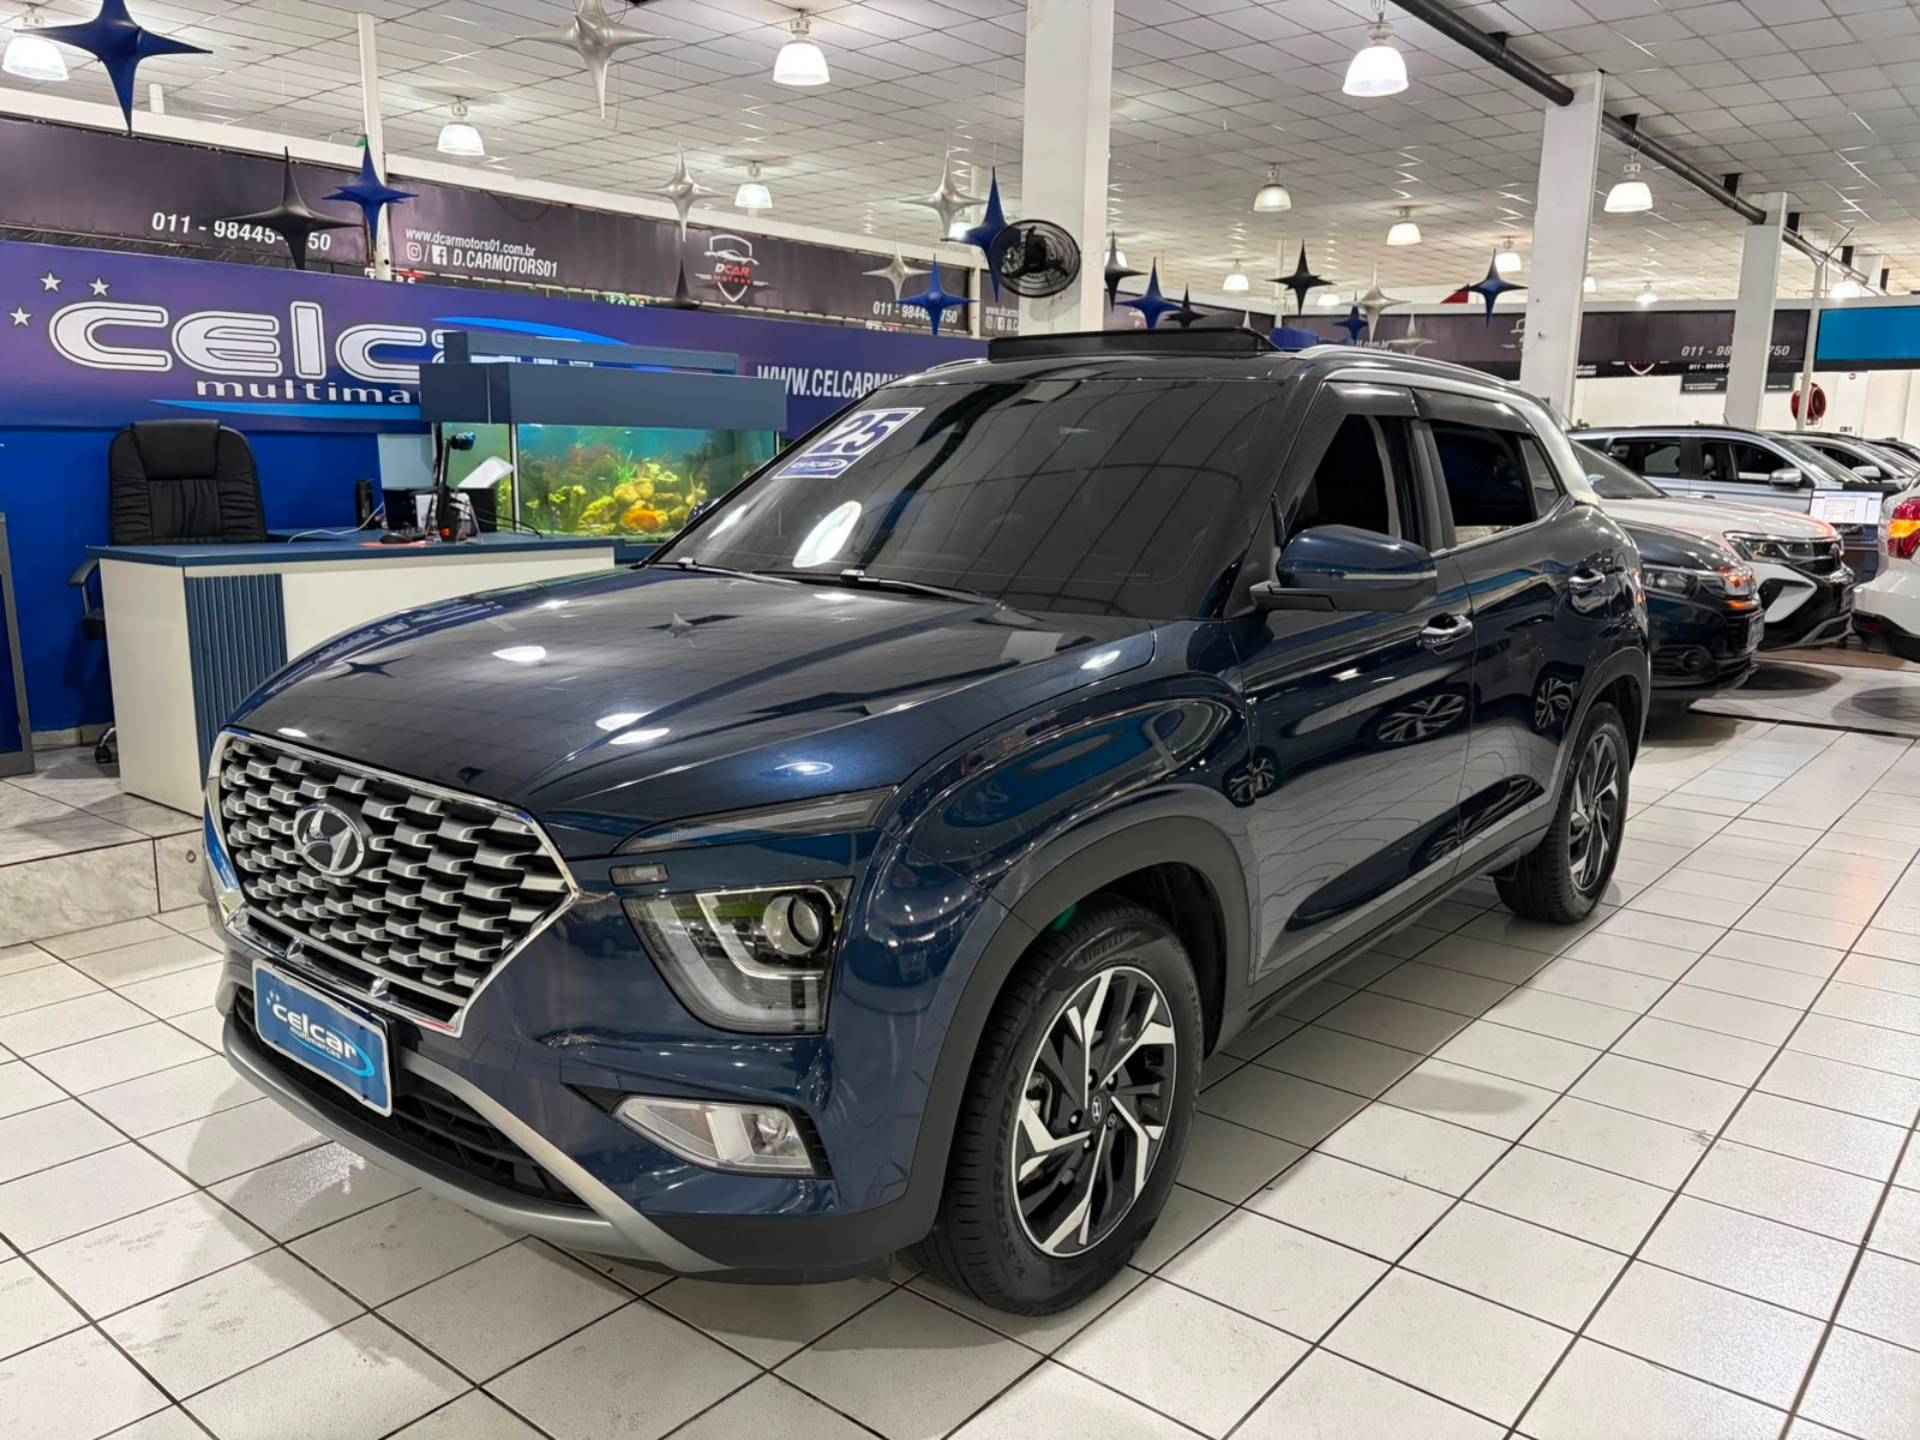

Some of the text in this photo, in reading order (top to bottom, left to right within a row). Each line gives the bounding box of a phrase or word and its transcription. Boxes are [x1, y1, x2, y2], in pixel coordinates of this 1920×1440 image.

[152, 212, 191, 234] 011
[213, 219, 332, 251] 98445-50
[405, 228, 536, 257] www.dcarmotors01.com.br
[452, 249, 557, 278] D.CARMOTORS01
[873, 300, 892, 317] 011
[1681, 345, 1704, 357] 011
[196, 379, 420, 406] multima
[808, 412, 912, 455] 25
[271, 1003, 358, 1060] celcar
